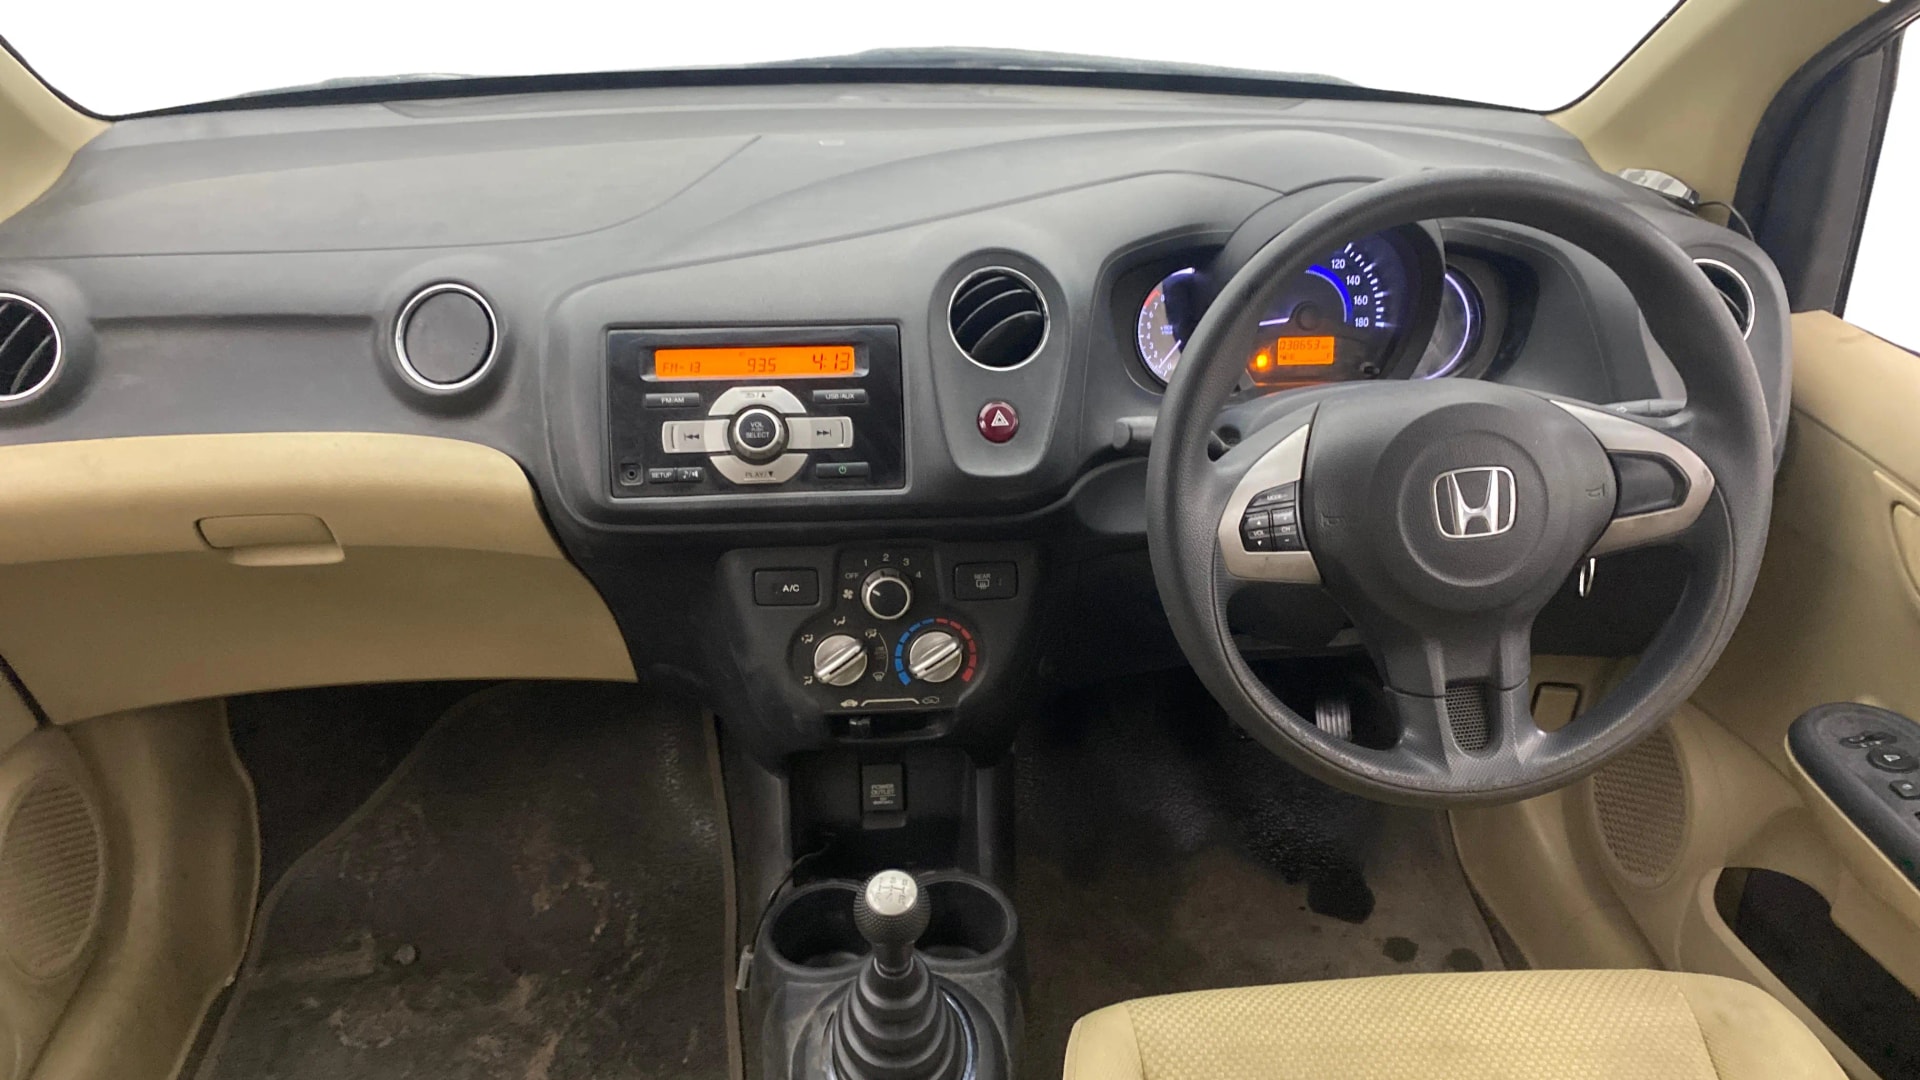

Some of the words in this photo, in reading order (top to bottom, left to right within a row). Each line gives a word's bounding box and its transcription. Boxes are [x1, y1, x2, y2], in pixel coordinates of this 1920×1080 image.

[1331, 258, 1346, 270] 120
[1346, 275, 1361, 286] 140
[1353, 295, 1368, 306] 160
[1153, 302, 1158, 310] 7
[1355, 317, 1369, 328] 180
[812, 352, 850, 372] 4:13
[882, 553, 889, 562] 2
[902, 558, 910, 567] 3
[863, 559, 868, 567] 1
[844, 572, 859, 580] OFF
[782, 583, 800, 593] A/C
